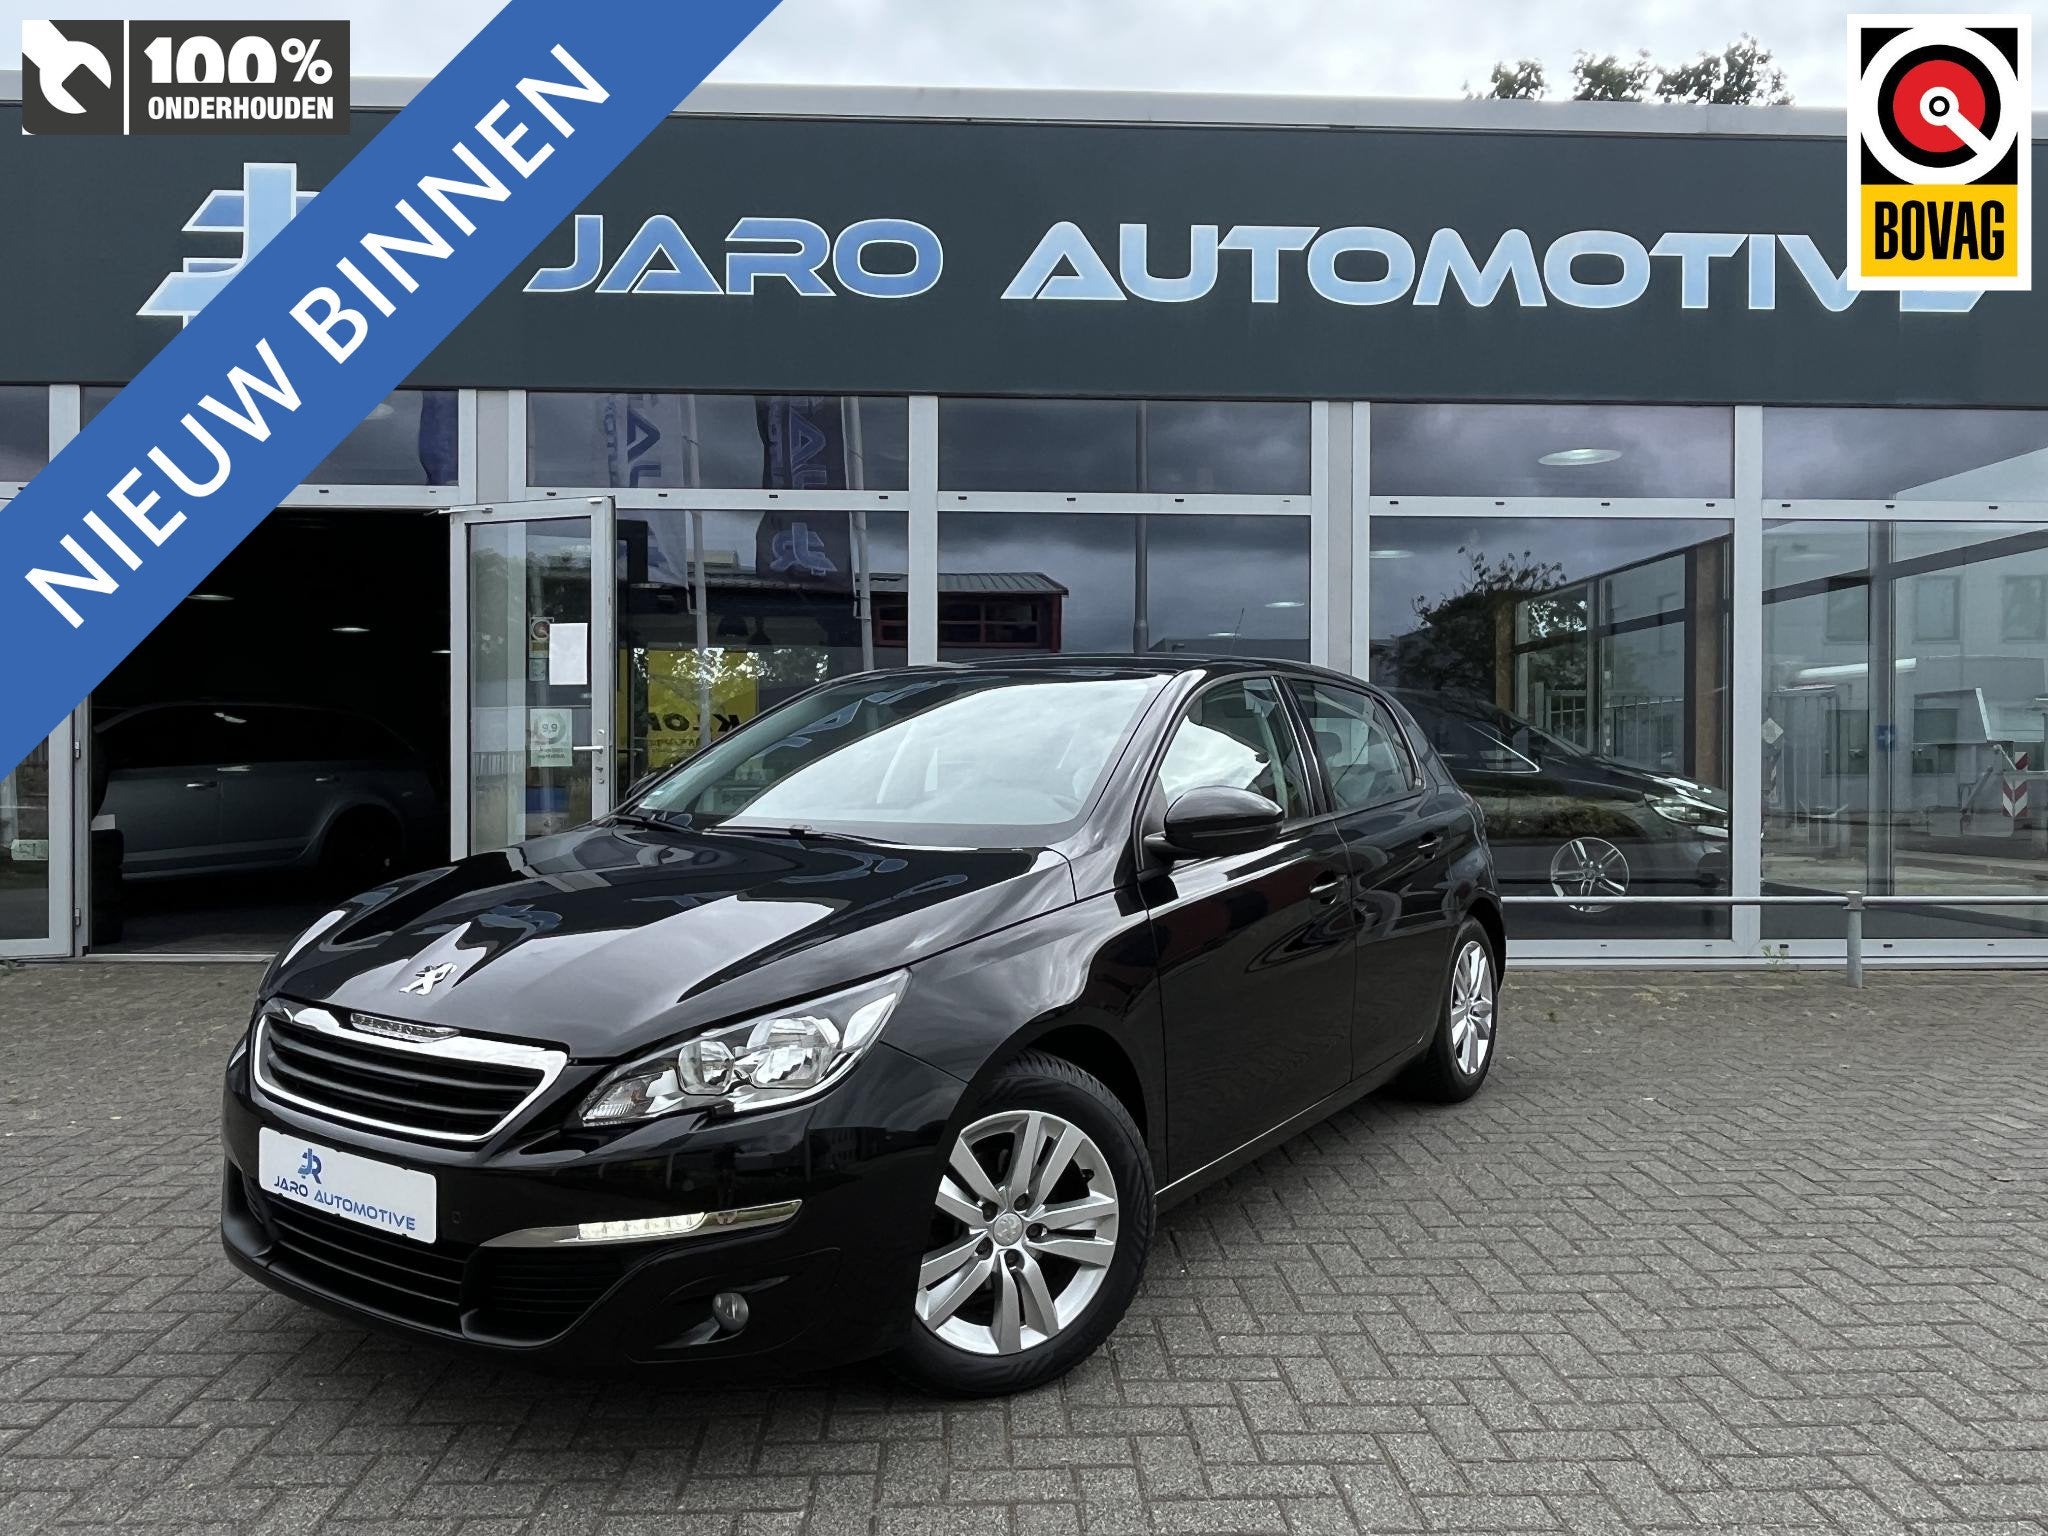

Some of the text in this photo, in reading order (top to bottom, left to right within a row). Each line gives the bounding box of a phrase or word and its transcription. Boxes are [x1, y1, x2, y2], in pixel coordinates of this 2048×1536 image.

[522, 214, 1986, 312] JARO AUTOMOTIV
[273, 1175, 416, 1231] JARO AUTOMOTIVE
